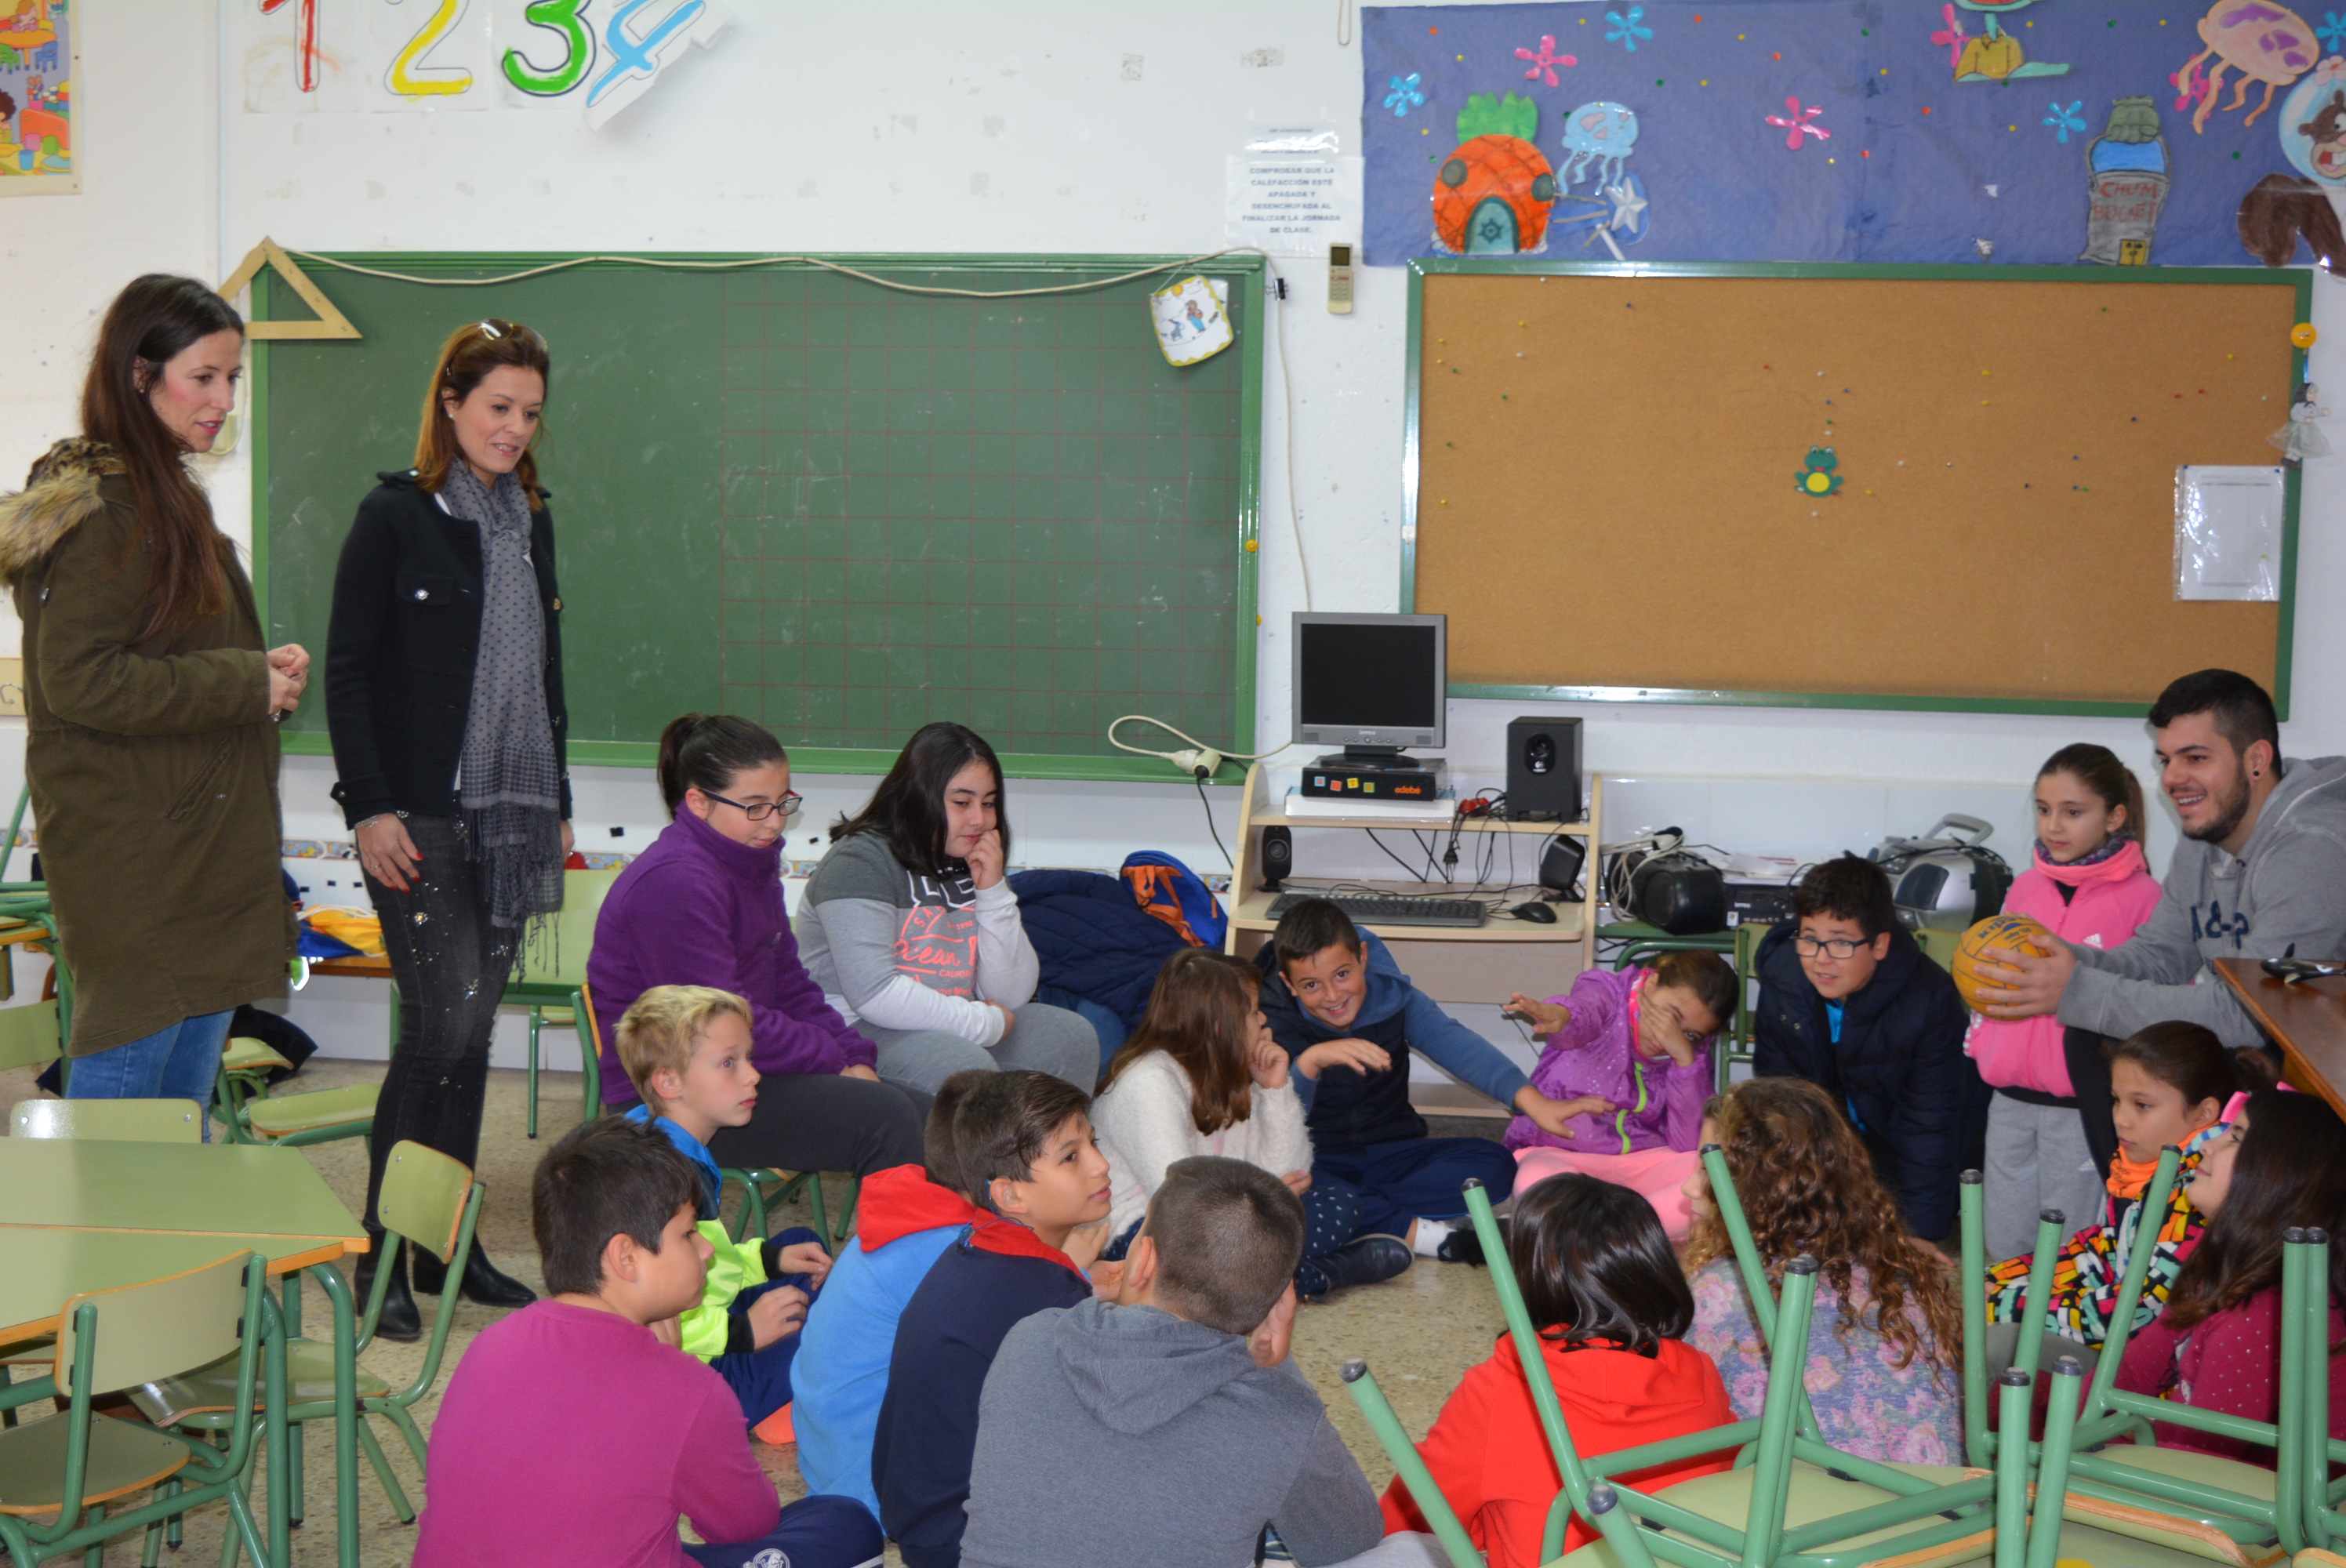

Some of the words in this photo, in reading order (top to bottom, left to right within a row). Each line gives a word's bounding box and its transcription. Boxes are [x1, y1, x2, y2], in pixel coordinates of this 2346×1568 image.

[258, 0, 320, 93] 1
[384, 0, 474, 100] 2
[502, 0, 596, 96] 3
[586, 0, 706, 107] 4
[2101, 181, 2158, 200] CHUM
[1394, 785, 1422, 795] edebé
